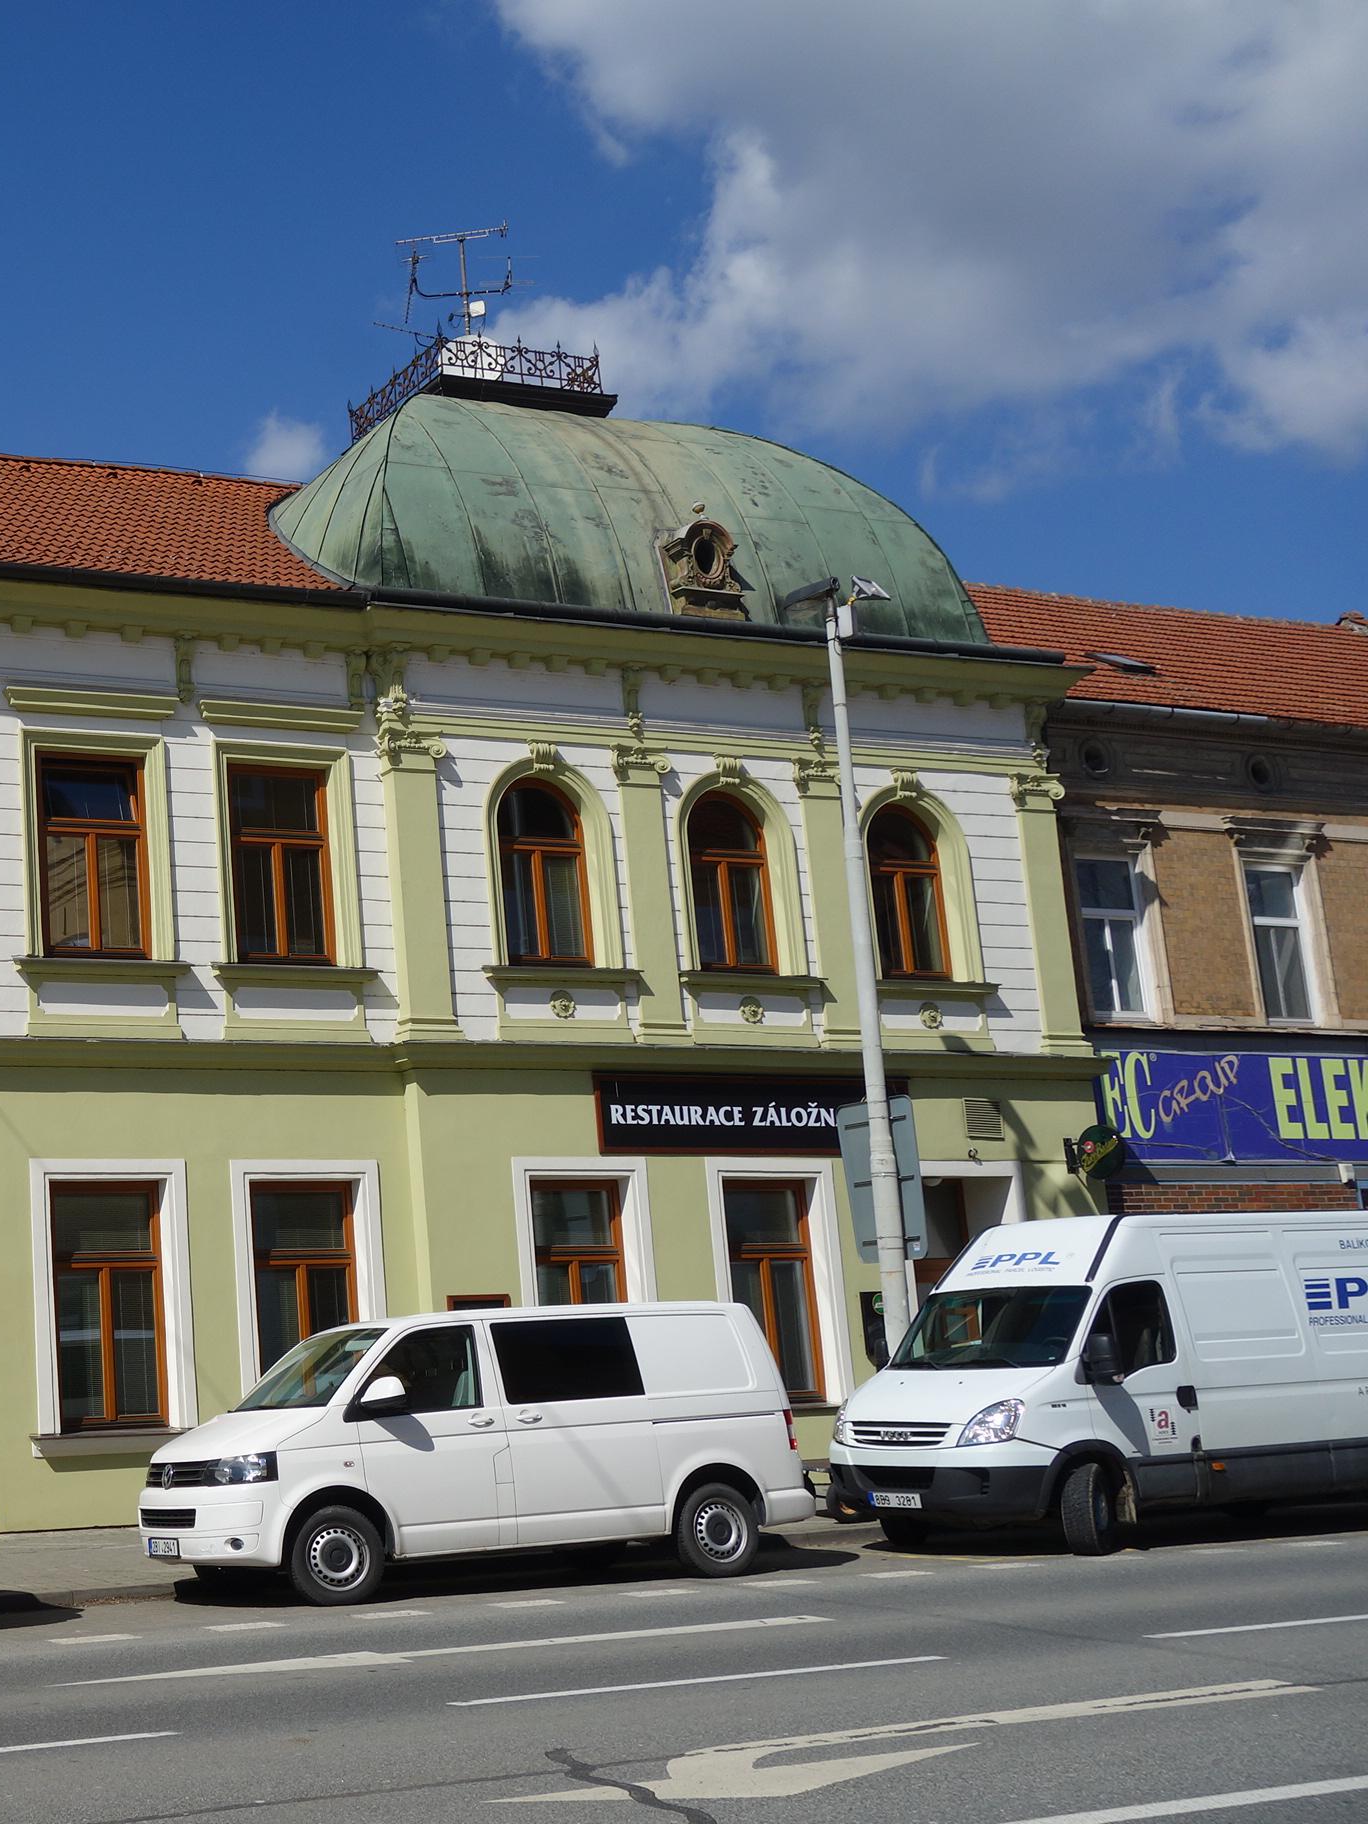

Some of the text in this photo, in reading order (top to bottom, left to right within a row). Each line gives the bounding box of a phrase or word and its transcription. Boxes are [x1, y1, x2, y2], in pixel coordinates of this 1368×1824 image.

[1157, 1054, 1241, 1123] GROUP
[609, 1101, 838, 1127] RESTAURACE ZÁLOŽN
[988, 1251, 1060, 1268] PPL
[1308, 1314, 1368, 1326] PROFESSIONAL
[875, 1494, 891, 1505] 8B9
